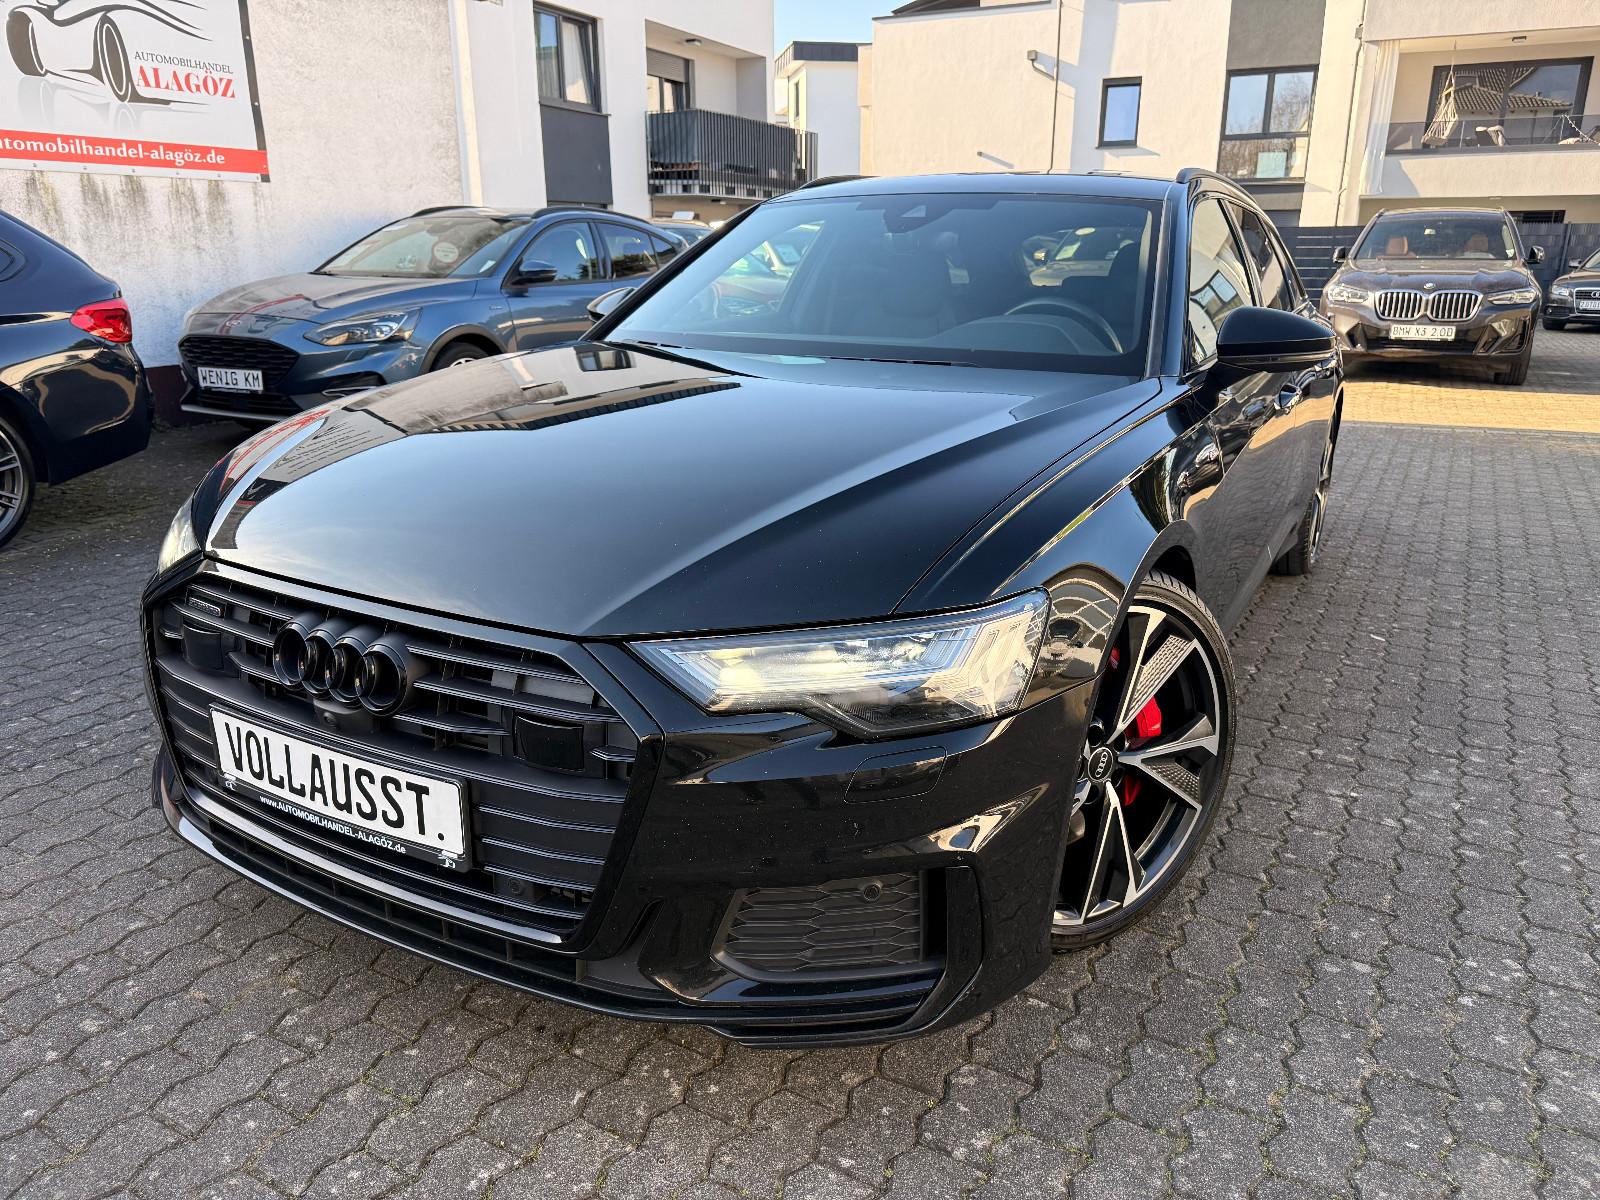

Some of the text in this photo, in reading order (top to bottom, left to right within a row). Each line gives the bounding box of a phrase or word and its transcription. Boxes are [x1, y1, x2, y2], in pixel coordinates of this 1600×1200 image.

[134, 51, 233, 75] AUTOMOBILHANDEL
[137, 65, 236, 99] ALAGÖZ
[0, 137, 225, 166] tomobilhandel-alagöz.de
[1393, 326, 1411, 336] BMW
[1415, 327, 1427, 337] X3
[200, 369, 260, 388] WENIG KM
[225, 721, 445, 842] VOLLAUSST.
[259, 795, 407, 854] www.AUTOMOBILHANDEL-ALAGÖZ.de
